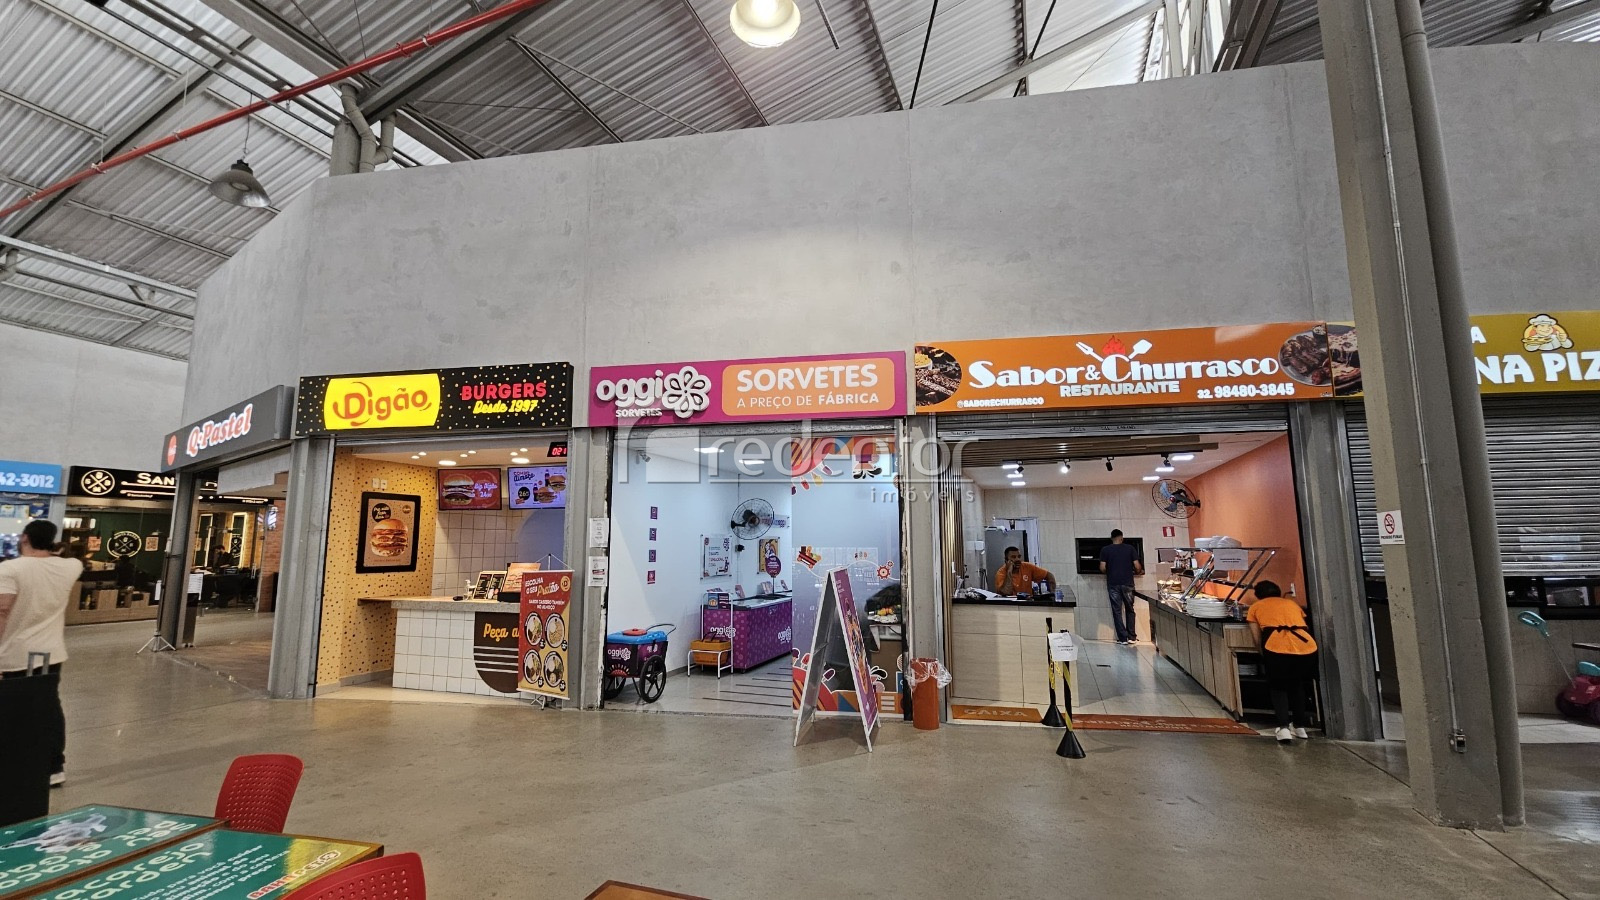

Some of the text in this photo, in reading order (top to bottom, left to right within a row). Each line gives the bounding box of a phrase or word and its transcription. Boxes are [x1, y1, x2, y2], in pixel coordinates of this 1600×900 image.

[736, 363, 879, 392] SORVETES
[968, 361, 1086, 389] Sabor
[1100, 354, 1280, 383] Churrasco
[461, 382, 547, 401] BURGERS
[596, 369, 663, 408] oggi
[1060, 380, 1181, 397] RESTAURANTE
[1214, 382, 1295, 399] 98480-3845
[333, 381, 432, 427] Digão
[473, 399, 539, 414] Desde 1997
[736, 391, 879, 411] A PREÇO DE FÁBRICA
[956, 397, 1044, 409] @SABORECHURRASCO
[615, 408, 663, 418] SORVETES
[483, 623, 509, 642] Peça
[963, 708, 1028, 718] CAIXA
[54, 842, 204, 900] acarejo
[90, 852, 213, 900] arden
